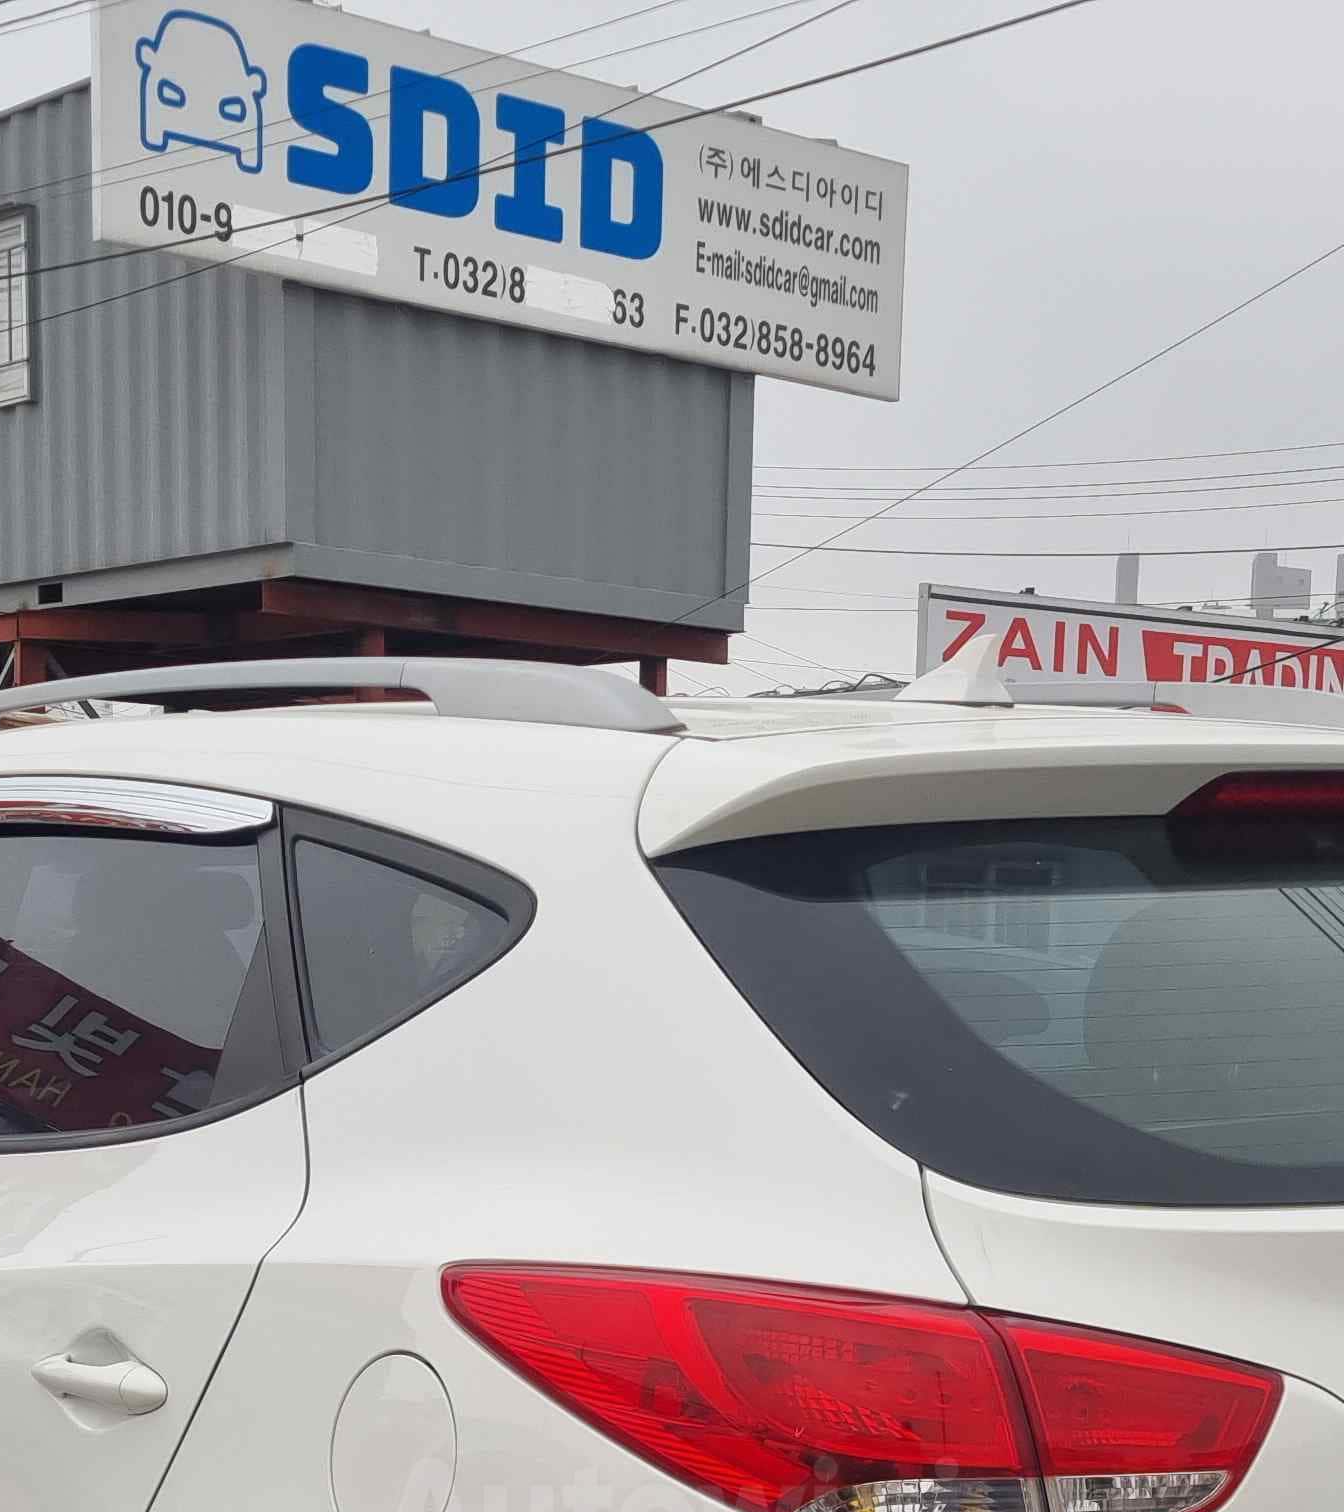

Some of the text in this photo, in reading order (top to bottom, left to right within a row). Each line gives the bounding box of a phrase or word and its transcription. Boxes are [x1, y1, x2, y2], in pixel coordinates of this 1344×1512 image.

[287, 42, 664, 261] SDID
[698, 197, 881, 264] www.sdidcar.com
[675, 303, 876, 376] F.032)858-8964
[942, 610, 1119, 677] ZAIN
